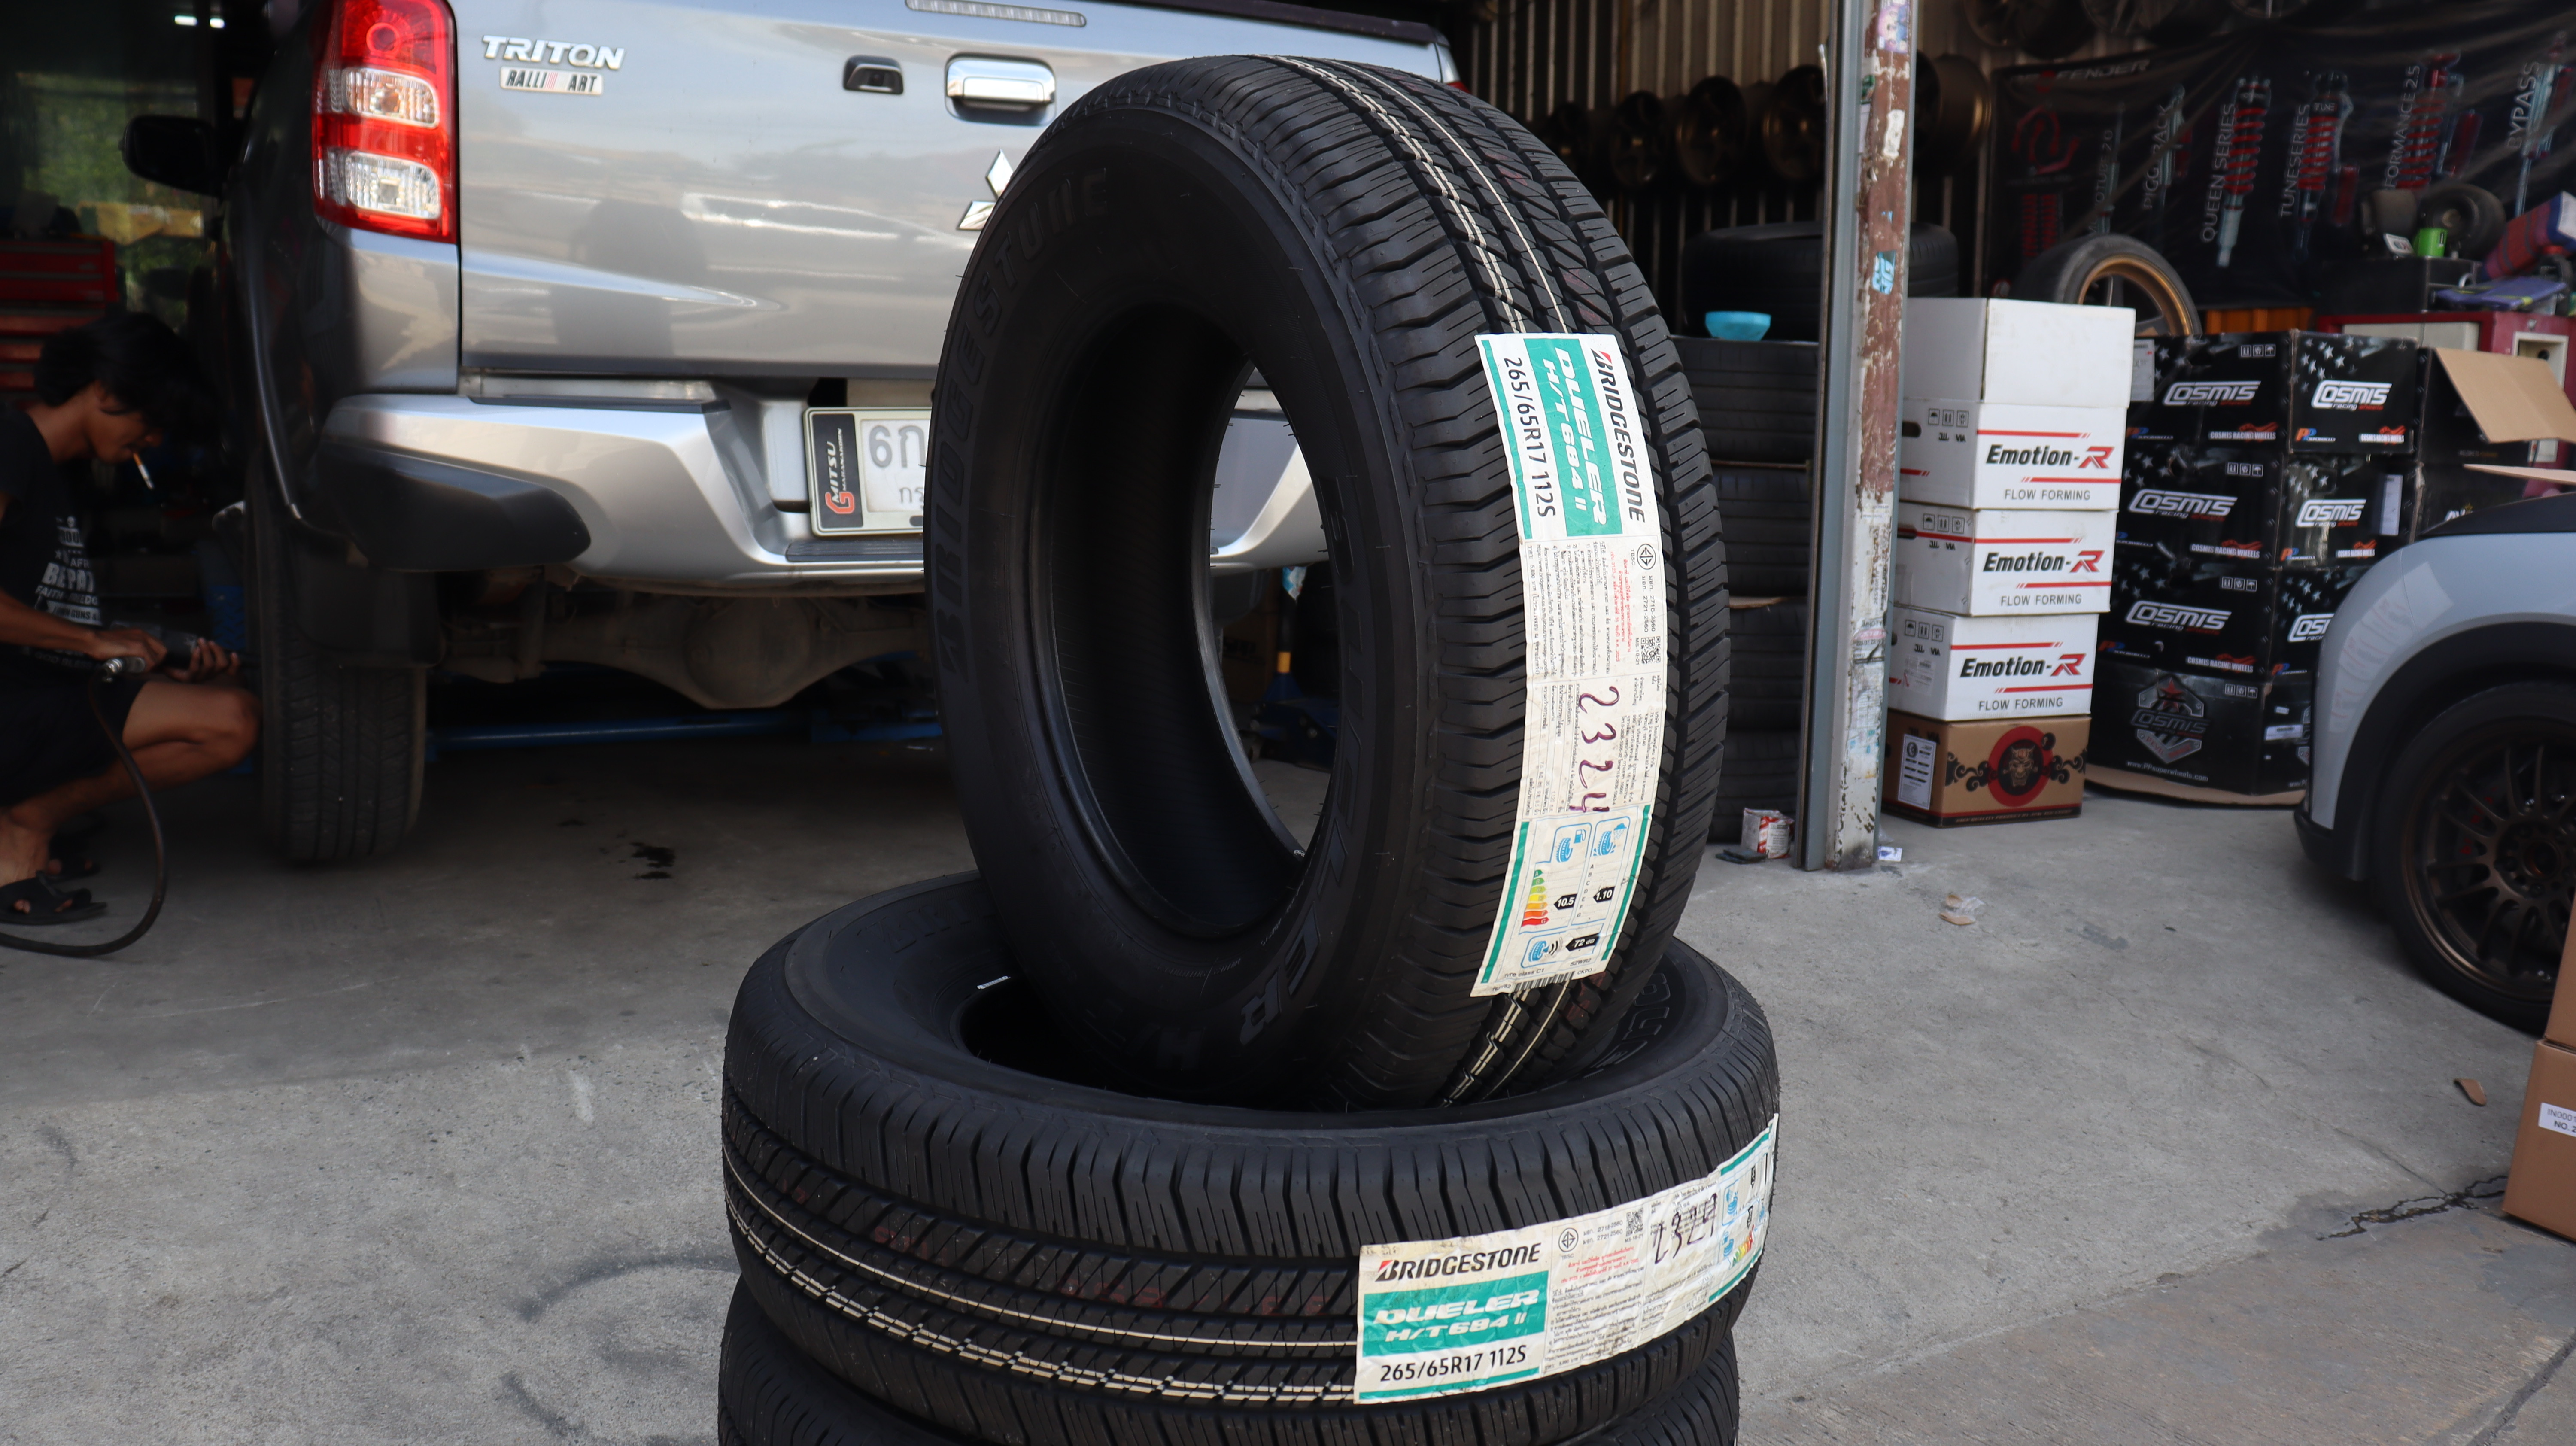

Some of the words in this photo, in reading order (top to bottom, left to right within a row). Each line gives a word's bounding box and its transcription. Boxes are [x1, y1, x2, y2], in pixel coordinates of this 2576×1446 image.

[482, 35, 625, 70] TRITON
[2509, 61, 2538, 149] BYPASS
[2200, 174, 2224, 243] QUEEN
[2214, 103, 2236, 169] SERIES
[2163, 380, 2261, 406] COSMIS
[2311, 380, 2393, 409] COSMIS
[2331, 403, 2358, 411] racing
[1503, 357, 1548, 464] 265/65R17
[1531, 471, 1556, 517] 112S
[1555, 347, 1607, 525] DUELER
[1590, 347, 1645, 523] BRIDGESTONE
[1956, 434, 1966, 443] VIA
[2210, 431, 2233, 440] COSMIS
[2233, 431, 2254, 440] RACING
[2254, 431, 2276, 440] WHEELS
[1986, 444, 2115, 469] Emotion-R
[827, 441, 840, 503] MITSU
[2005, 489, 2036, 500] FLOW
[2041, 489, 2091, 501] FORMING
[2128, 489, 2238, 515] COSMIS
[2295, 499, 2367, 528] COSMIS
[1946, 542, 1956, 551] VIA
[2191, 544, 2215, 553] COSMIS
[2215, 546, 2237, 556] RACING
[2237, 548, 2260, 559] WHEELS
[1983, 550, 2105, 573] Emotion-R
[2001, 595, 2030, 606] FLOW
[2035, 594, 2082, 605] FORMING
[2125, 600, 2232, 630] COSMIS
[1931, 647, 1941, 656] VIA
[1959, 653, 2087, 678] Emotion-R
[2187, 656, 2210, 667] COSMIS
[2210, 659, 2232, 670] RACING
[2231, 662, 2254, 673] WHEELS
[1979, 699, 2010, 711] FLOW
[2014, 697, 2063, 709] FORMING
[1569, 686, 1620, 813] 2324
[2126, 760, 2209, 782] www.PPsuperwheels.com
[1557, 896, 1576, 907] 10.5
[1595, 890, 1613, 901] 1.10
[1574, 939, 1585, 948] 72
[2554, 1120, 2570, 1131] NO.
[1375, 1242, 1542, 1282] BRIDGESTONE
[1373, 1289, 1540, 1324] DUELER
[1380, 1353, 1484, 1382] 265/65R17
[1489, 1344, 1527, 1368] 112S
